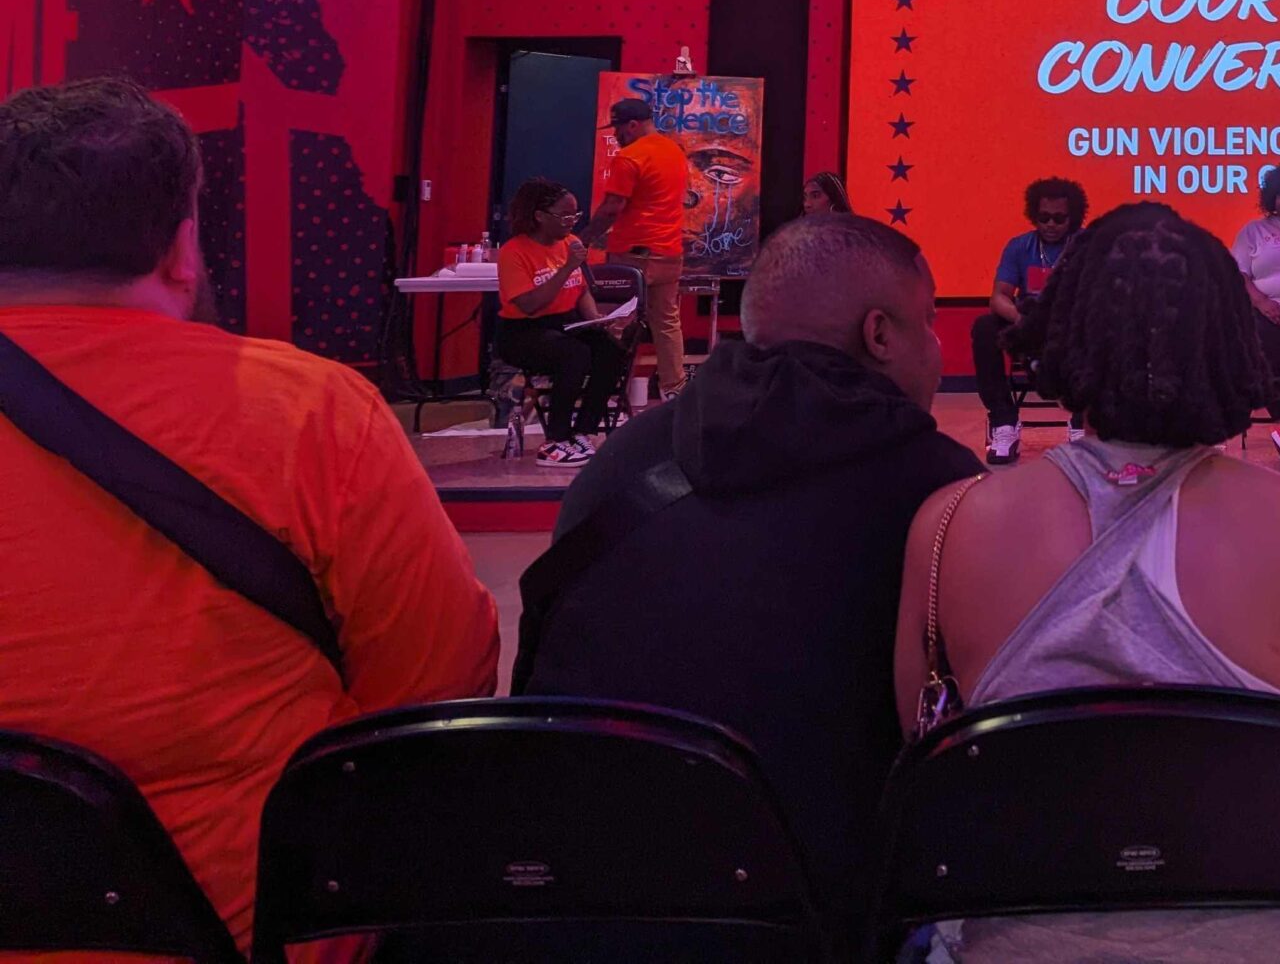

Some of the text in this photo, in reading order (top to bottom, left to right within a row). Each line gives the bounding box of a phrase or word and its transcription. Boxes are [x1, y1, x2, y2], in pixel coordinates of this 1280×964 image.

[628, 77, 740, 114] Stop the
[1068, 127, 1138, 156] GUN
[1134, 165, 1166, 193] IN
[1178, 165, 1247, 193] OUR
